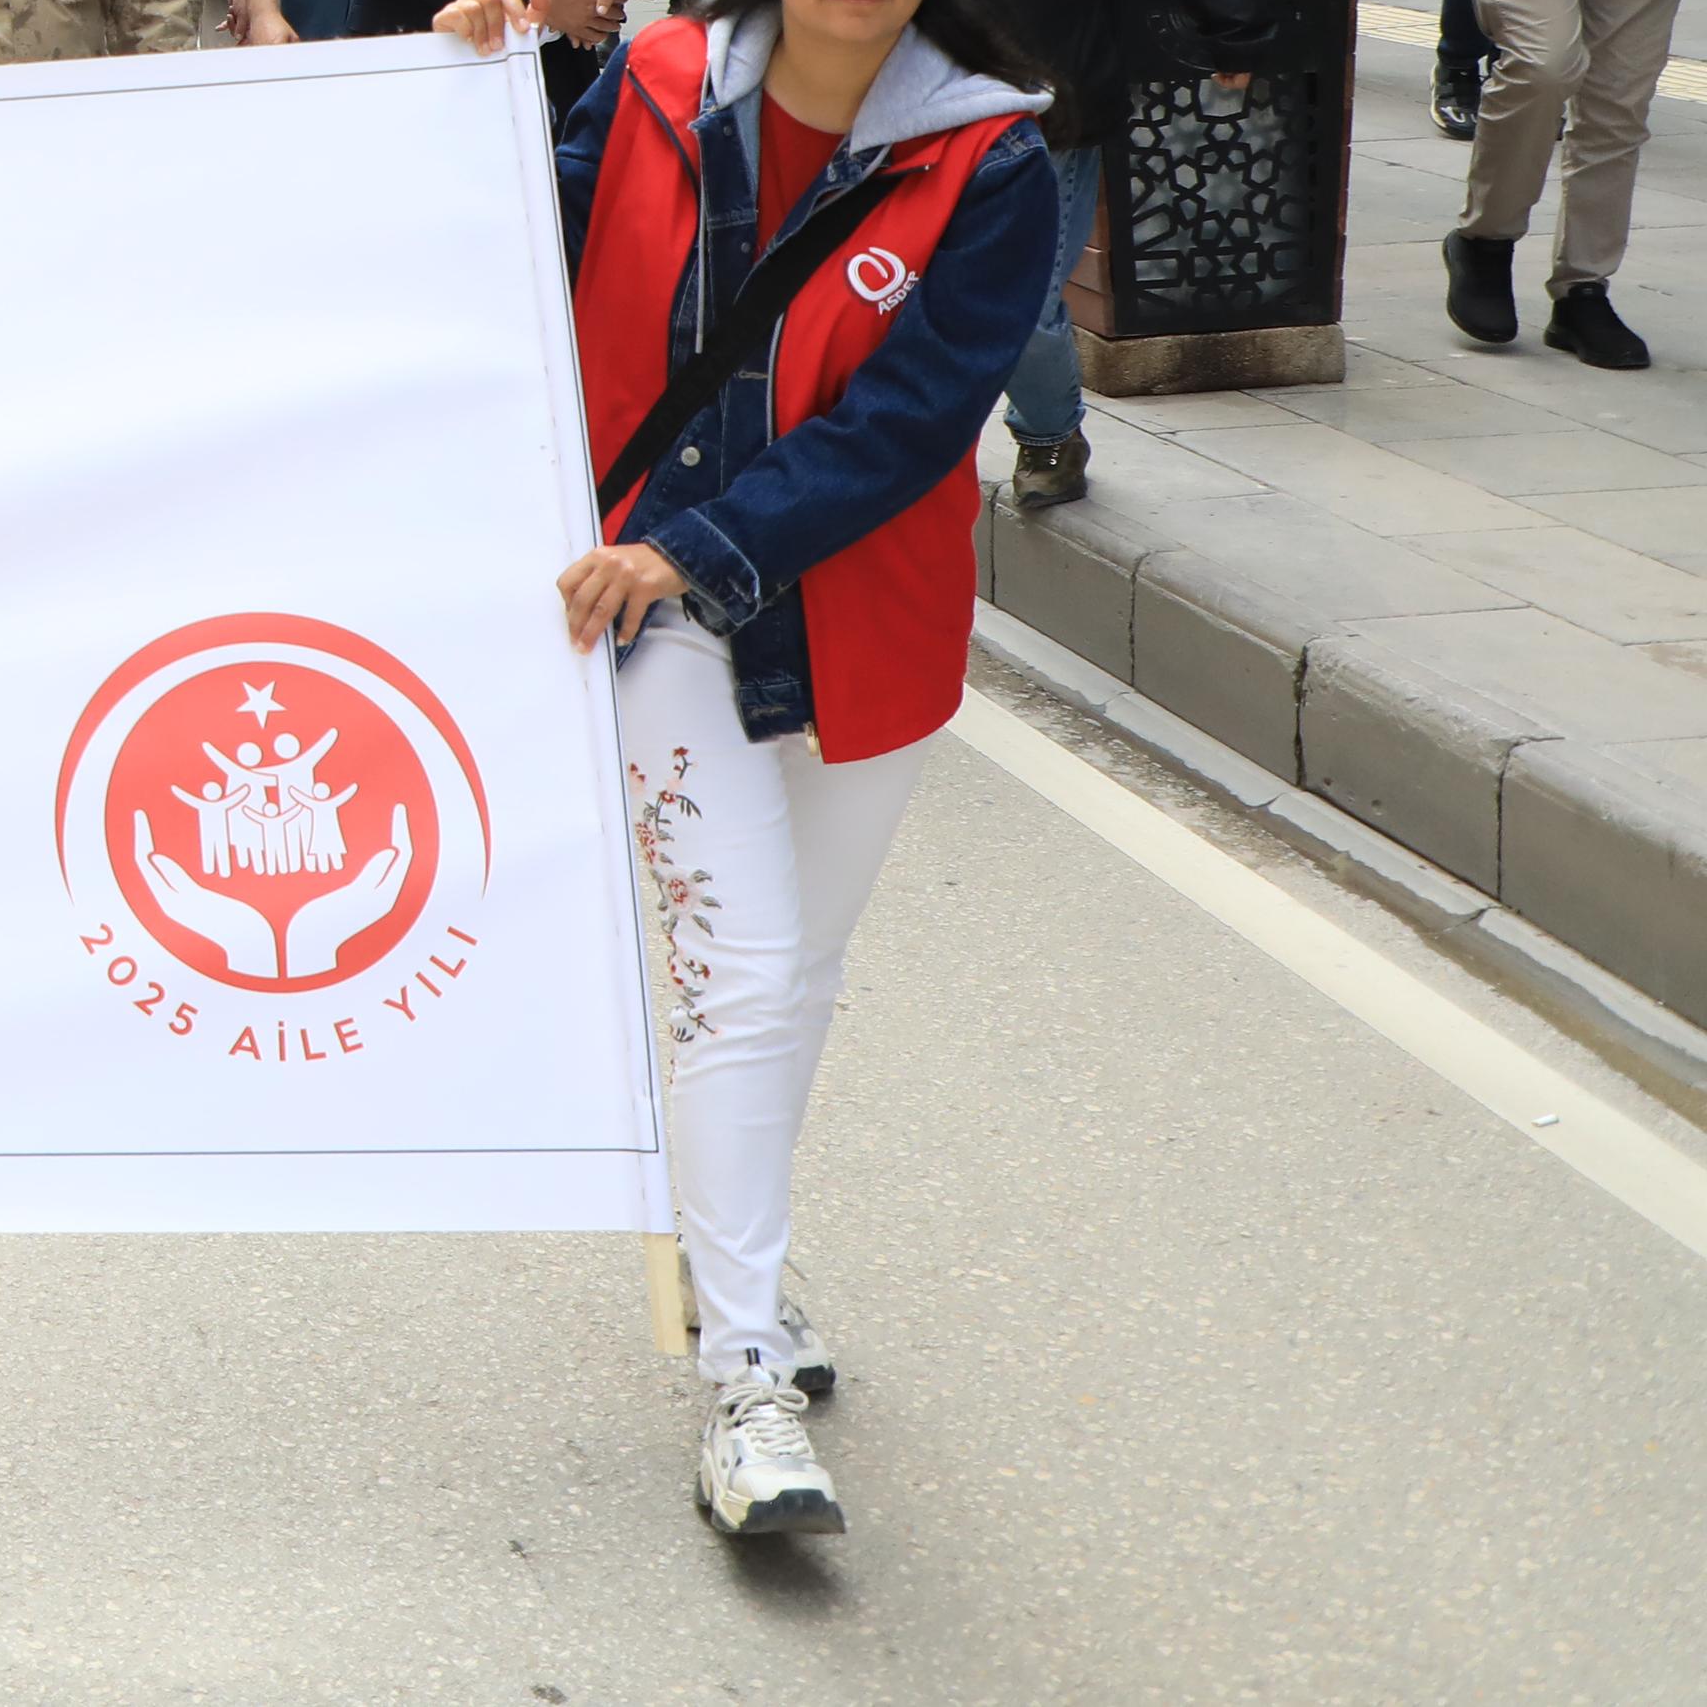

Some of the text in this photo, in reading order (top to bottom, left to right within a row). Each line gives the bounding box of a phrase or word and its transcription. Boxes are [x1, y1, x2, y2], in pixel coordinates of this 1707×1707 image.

[876, 270, 921, 316] ASDEP
[78, 922, 479, 1063] 2025 AİLE YILI
